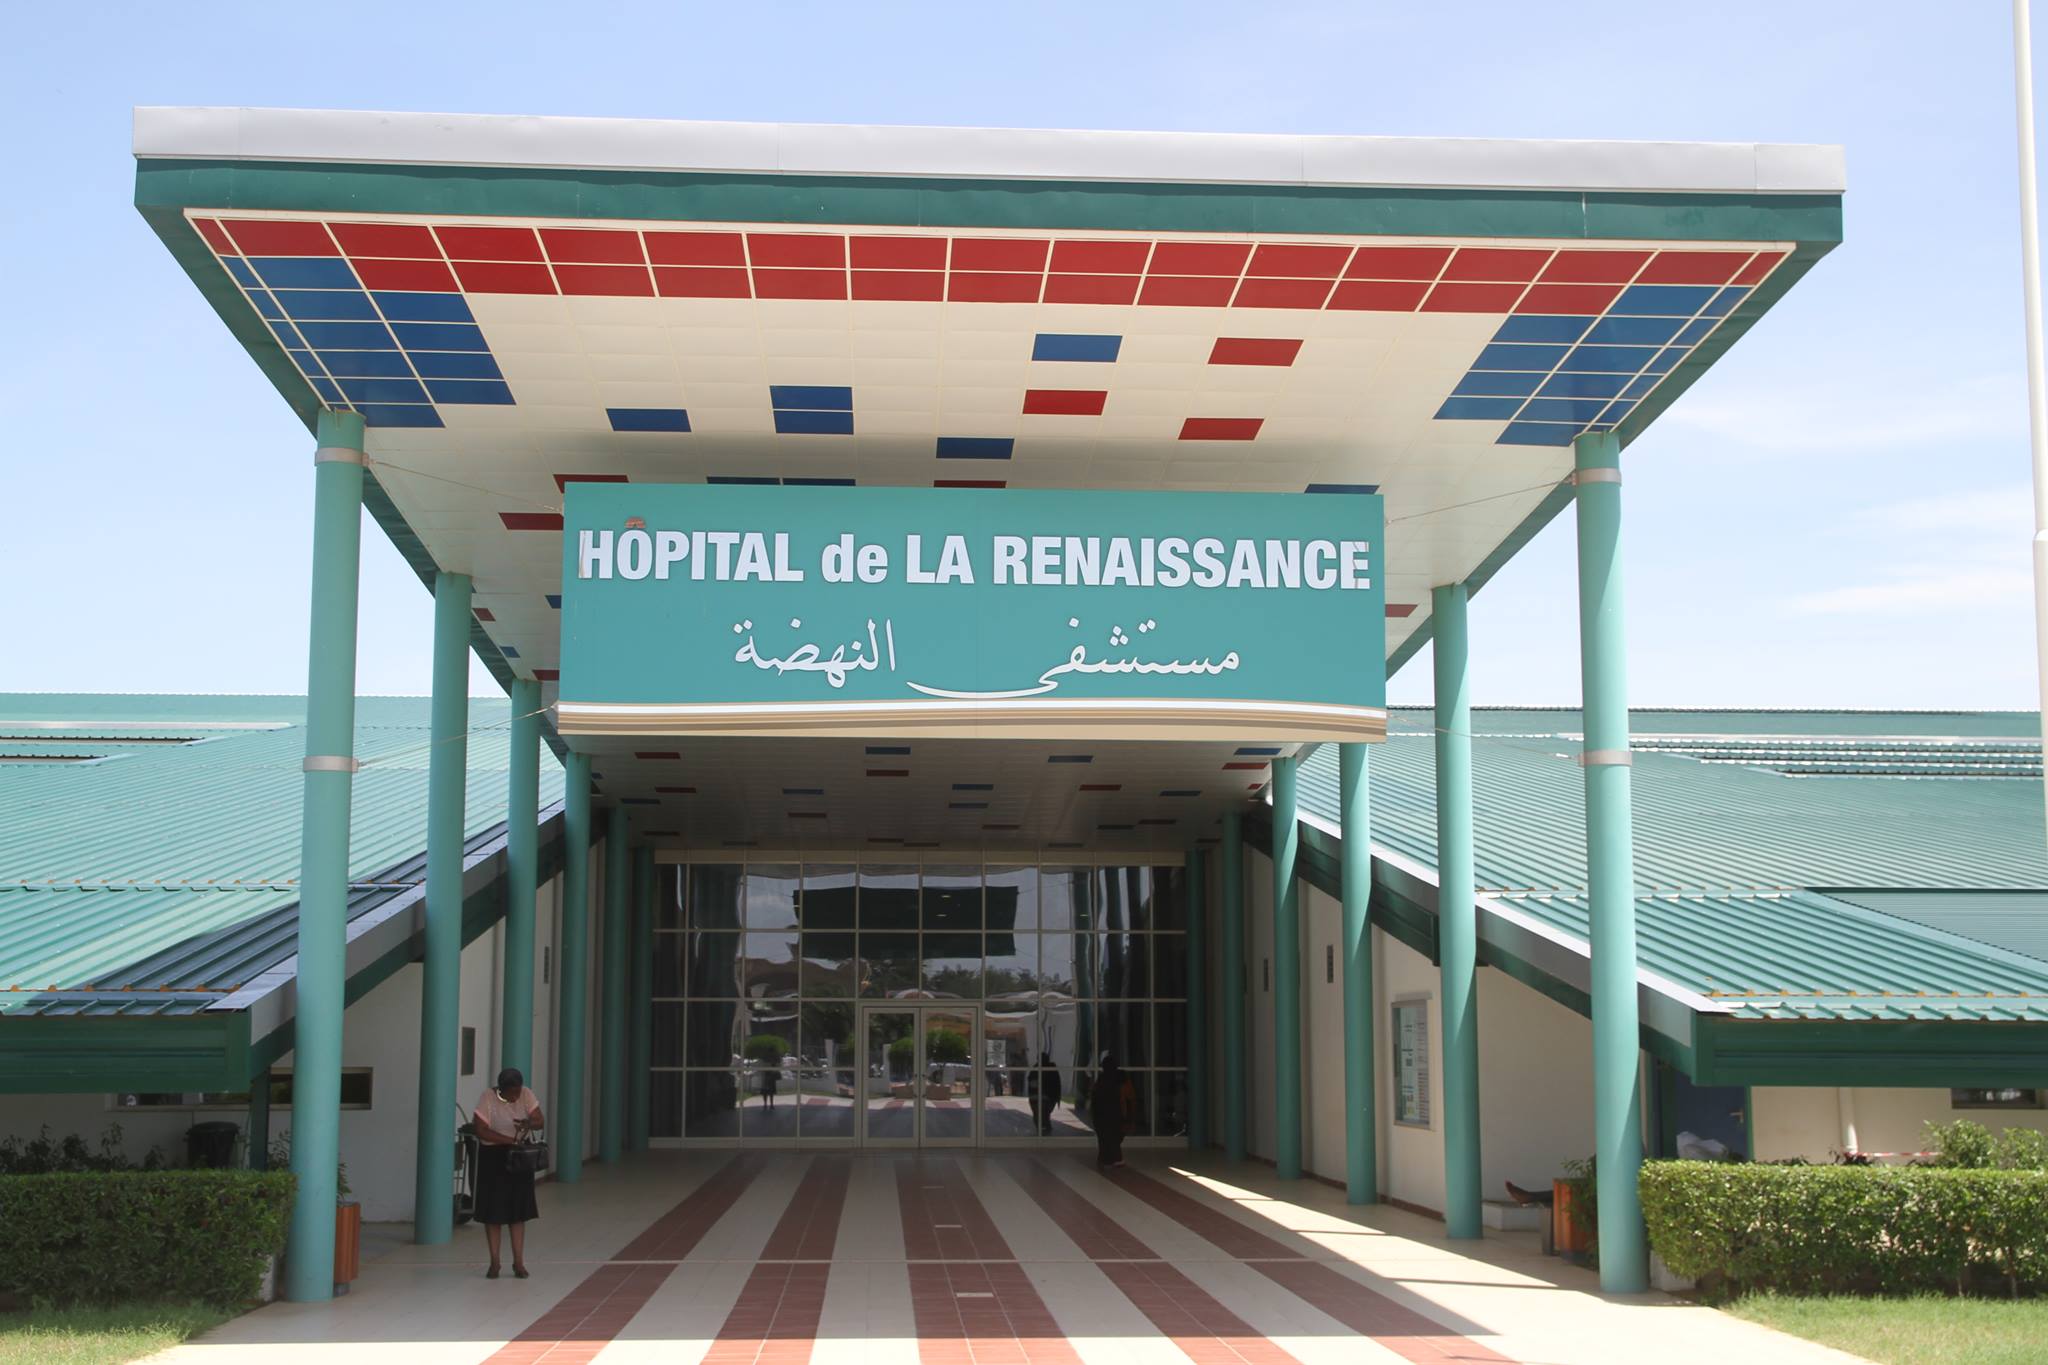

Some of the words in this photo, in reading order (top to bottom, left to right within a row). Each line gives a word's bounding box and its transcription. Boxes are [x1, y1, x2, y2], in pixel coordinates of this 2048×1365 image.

[822, 534, 888, 583] de
[906, 535, 975, 584] LA
[994, 536, 1371, 590] RENAISSANCE
[733, 618, 896, 688] النهضة
[907, 617, 1240, 698] مستشفى
